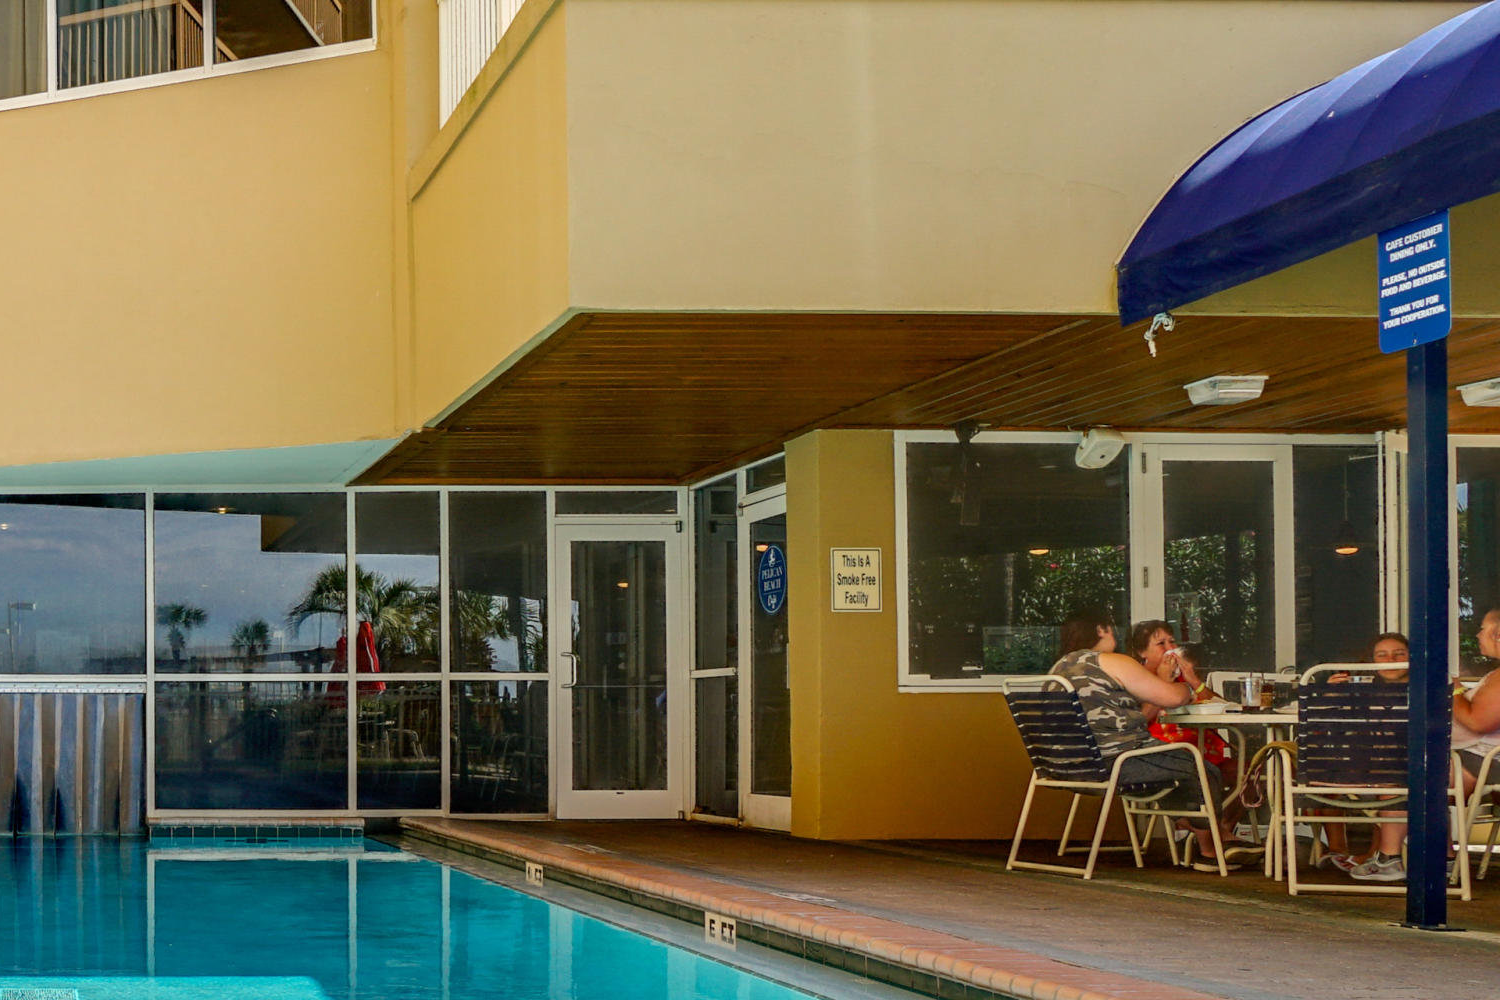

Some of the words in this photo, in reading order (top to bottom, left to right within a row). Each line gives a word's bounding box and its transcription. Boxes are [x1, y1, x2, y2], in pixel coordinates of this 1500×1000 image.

[1385, 237, 1403, 251] CAFE
[1404, 223, 1443, 245] CUSTOMER
[1390, 246, 1414, 262] DINING
[1414, 239, 1436, 253] ONLY.
[1381, 286, 1399, 298] FOOD
[1398, 281, 1412, 292] AND
[1412, 270, 1447, 288] BEVERAGE.
[1382, 272, 1407, 287] PLEASE,
[1407, 268, 1418, 279] NO
[1418, 258, 1446, 275] OUTSIDE
[1383, 317, 1401, 329] YOUR
[1401, 304, 1447, 324] COOPERATION.
[1389, 303, 1411, 317] THANK
[1411, 299, 1425, 310] YOU
[1425, 294, 1439, 306] FOR
[842, 555, 857, 568] This
[858, 555, 864, 567] Is
[865, 556, 871, 567] A
[762, 567, 783, 580] PELICAN
[764, 578, 781, 592] BEACH
[837, 573, 860, 586] Smoke
[861, 573, 876, 586] Free
[845, 592, 868, 607] Facility
